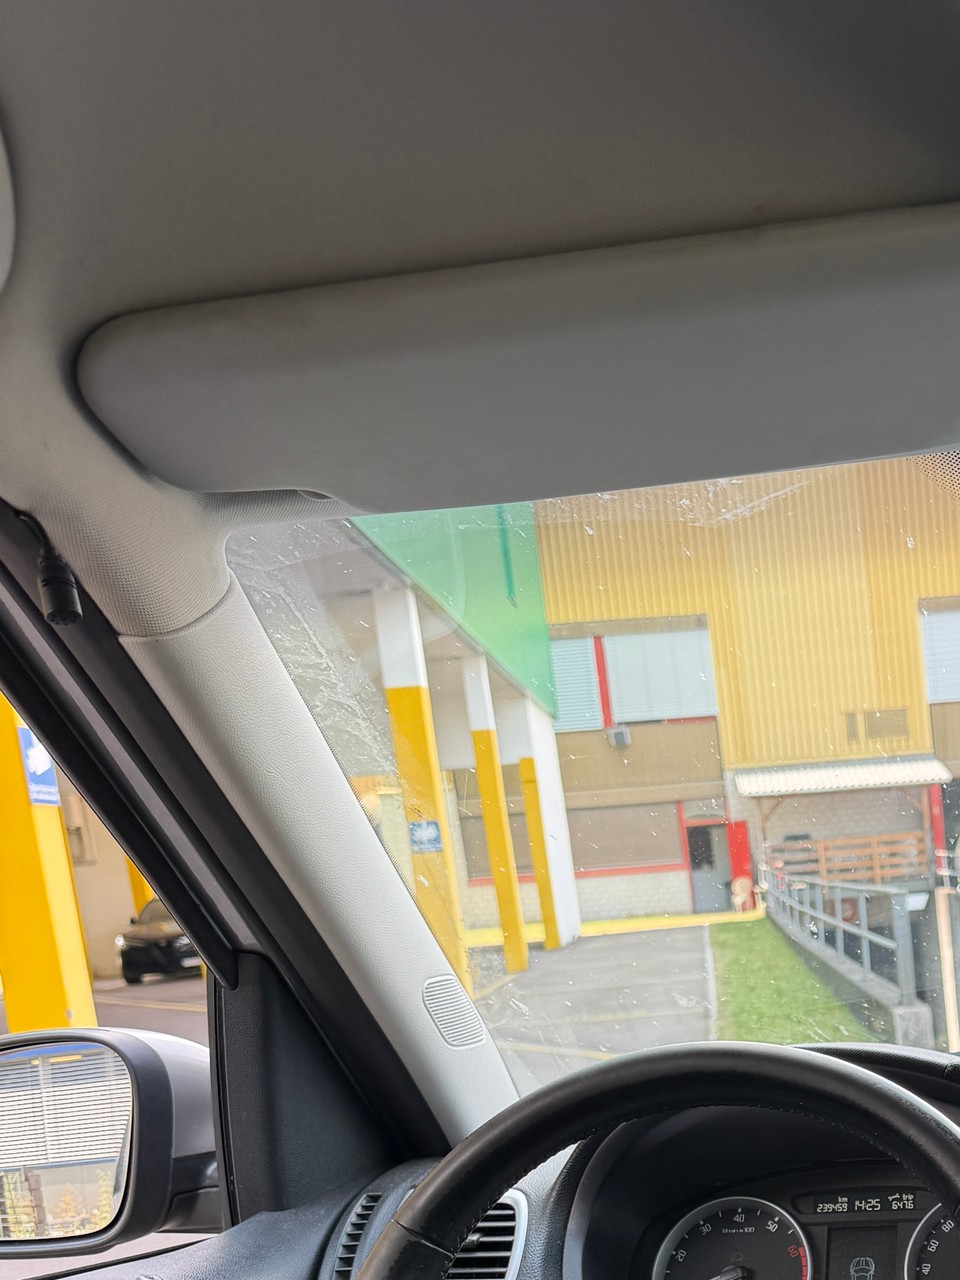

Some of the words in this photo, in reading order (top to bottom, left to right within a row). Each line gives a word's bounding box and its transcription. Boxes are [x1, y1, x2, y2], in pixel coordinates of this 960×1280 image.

[902, 1193, 914, 1201] trip
[817, 1203, 848, 1213] 239459
[854, 1199, 881, 1211] 14:25
[733, 1213, 745, 1223] 40
[699, 1224, 712, 1235] 30
[765, 1220, 779, 1233] 50
[941, 1219, 955, 1233] 80
[787, 1244, 799, 1258] 60
[927, 1239, 940, 1253] 60
[675, 1249, 687, 1262] 20
[921, 1263, 931, 1275] 40
